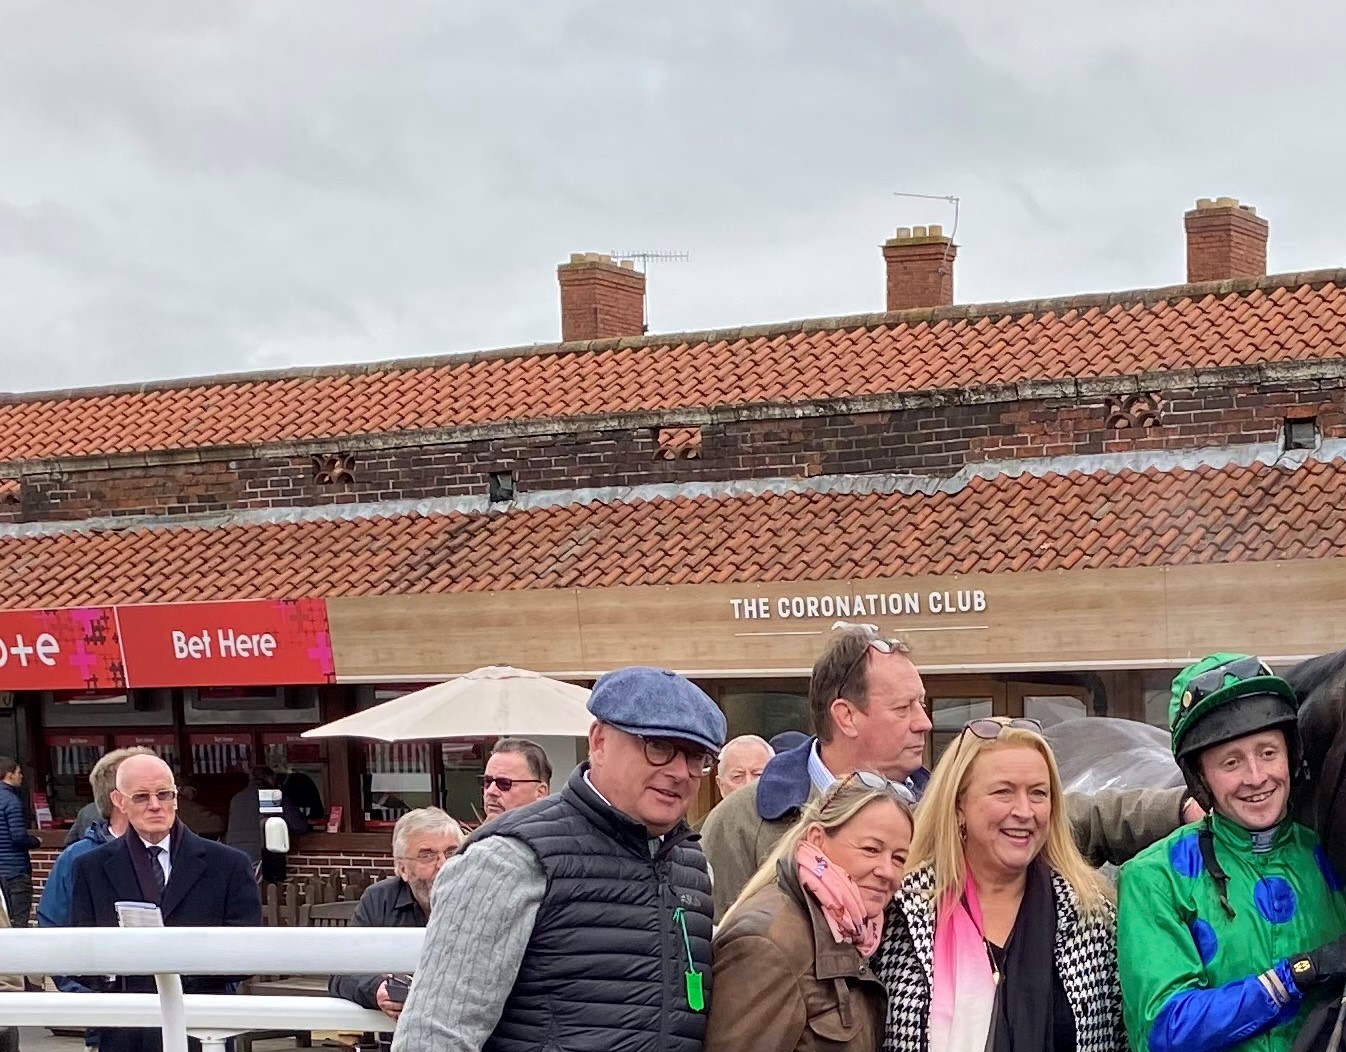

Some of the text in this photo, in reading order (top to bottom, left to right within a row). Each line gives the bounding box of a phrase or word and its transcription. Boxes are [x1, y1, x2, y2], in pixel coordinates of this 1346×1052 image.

[729, 590, 987, 619] THE CORONATION CLUB
[171, 628, 277, 659] Bet Here
